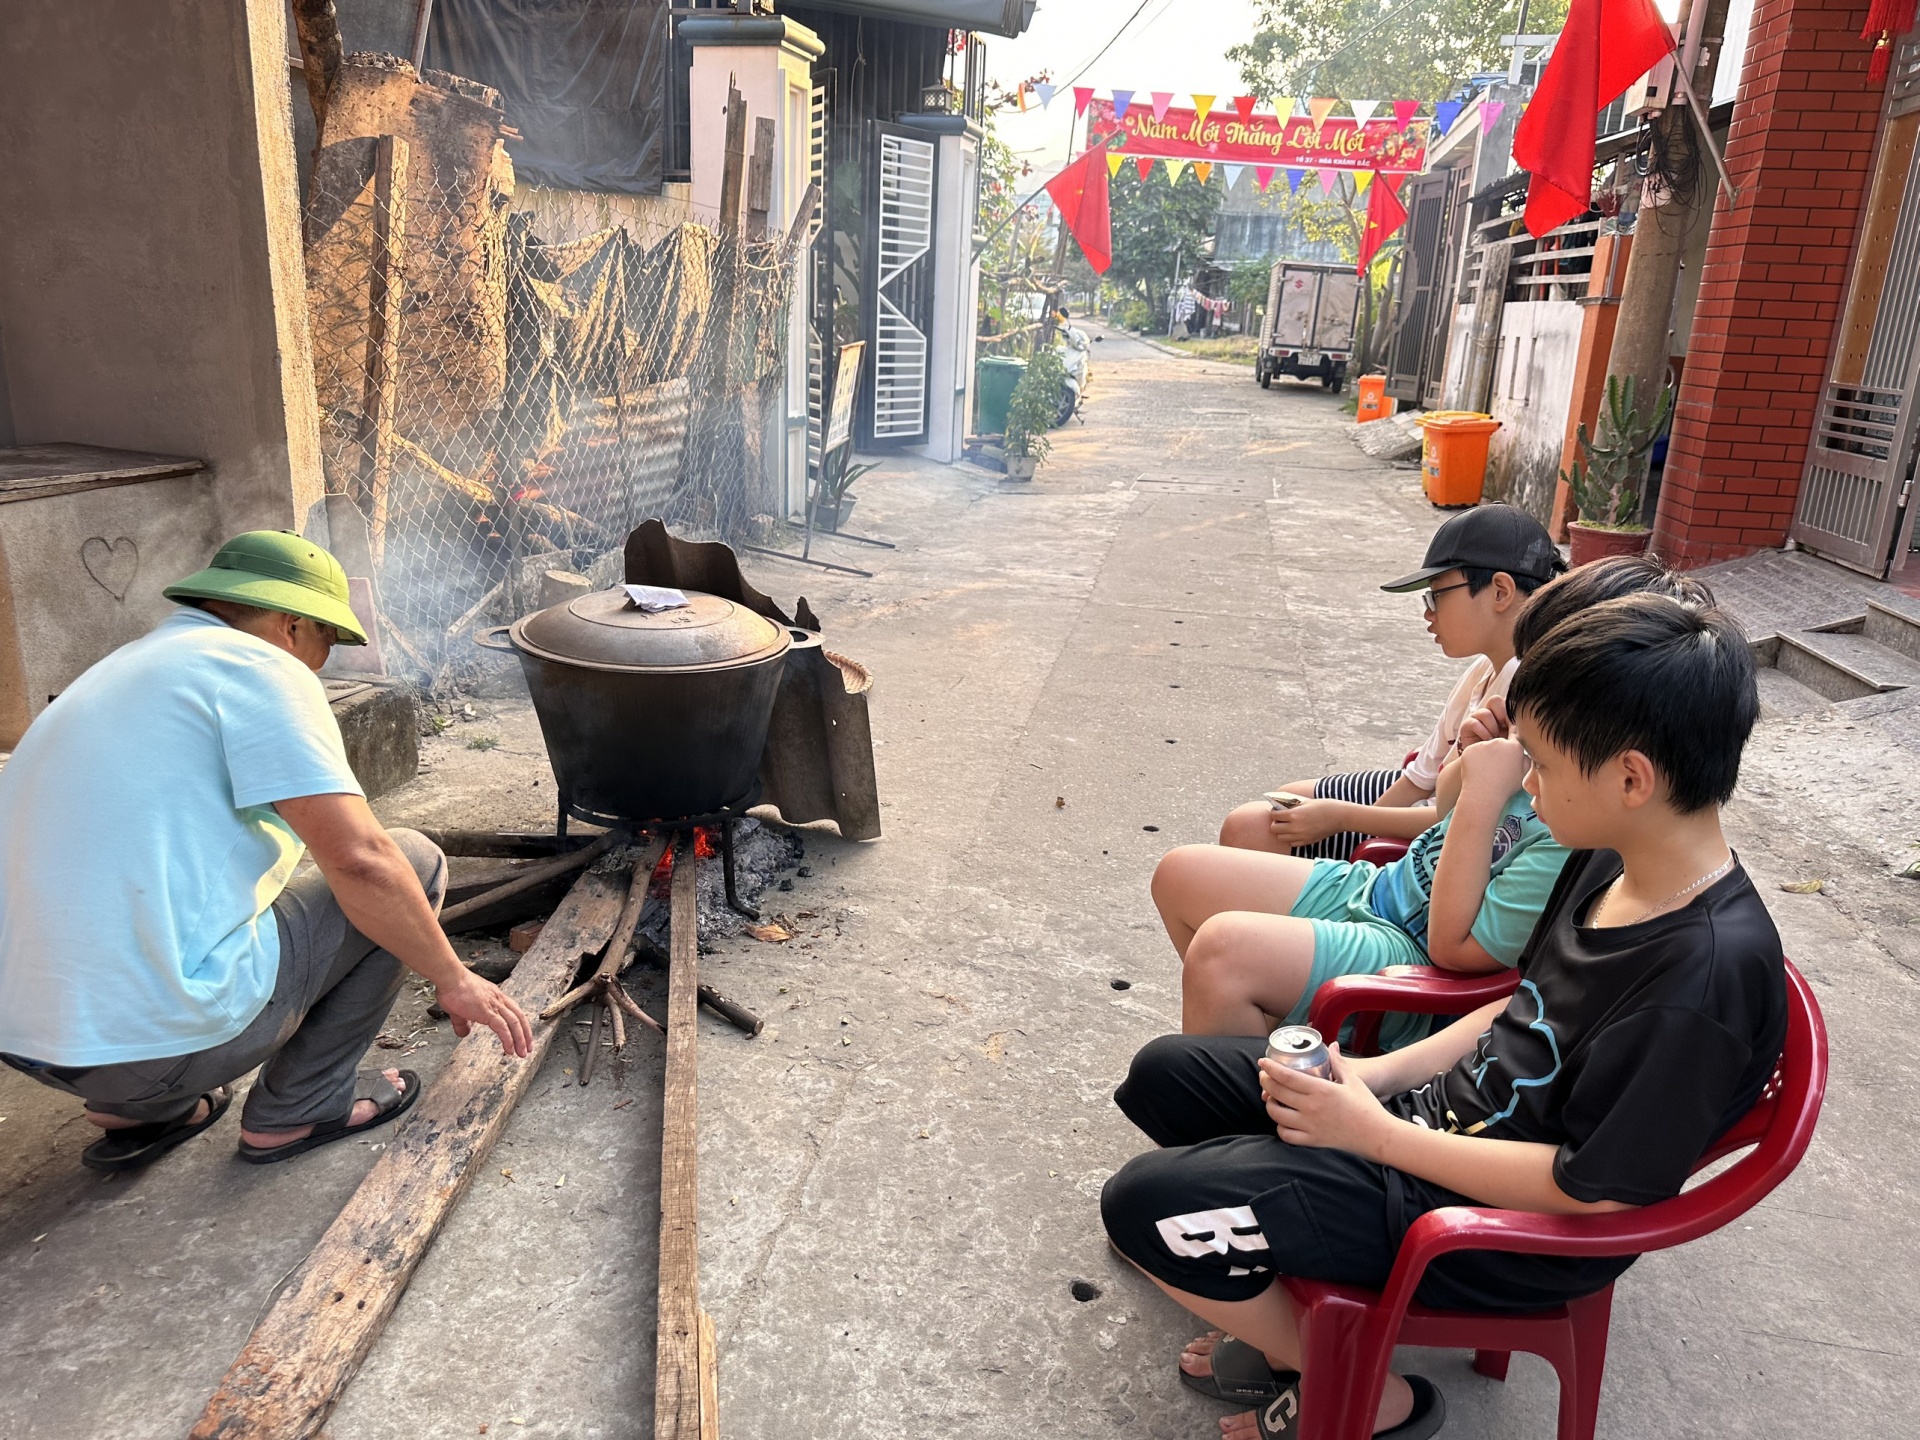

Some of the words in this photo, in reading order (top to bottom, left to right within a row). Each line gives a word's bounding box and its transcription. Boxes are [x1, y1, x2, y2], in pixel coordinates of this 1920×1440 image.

[1181, 119, 1221, 147] Mới
[1225, 120, 1284, 156] Thắng
[1286, 125, 1322, 154] Lợi
[1325, 128, 1366, 157] Mới
